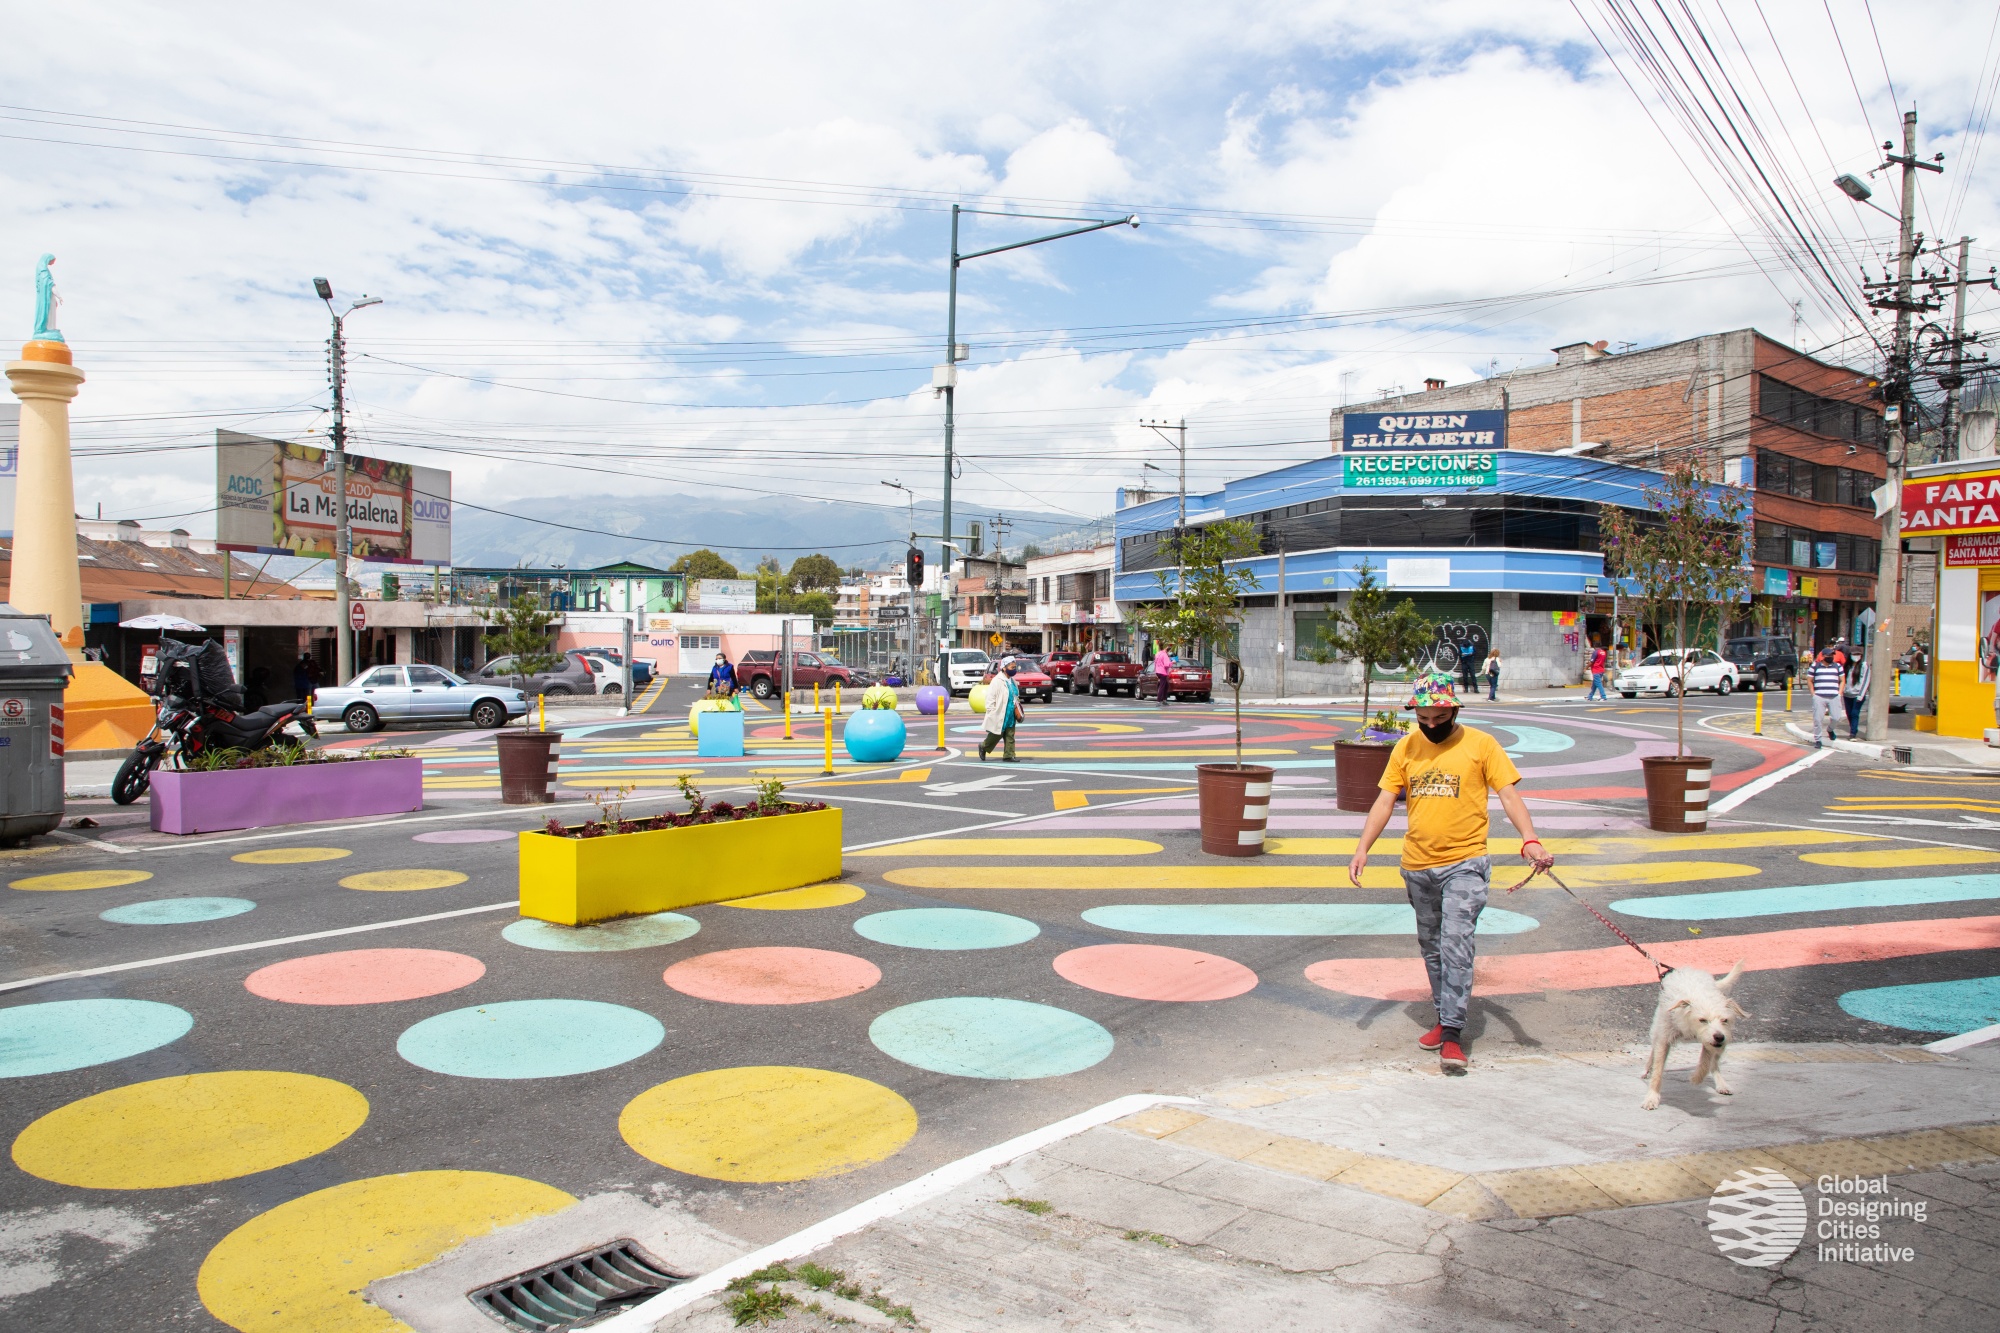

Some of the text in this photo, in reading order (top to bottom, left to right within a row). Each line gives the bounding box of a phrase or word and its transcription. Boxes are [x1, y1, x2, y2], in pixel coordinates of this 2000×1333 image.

[1378, 415, 1468, 432] QUEEN
[1350, 454, 1492, 472] RECEPCIONES
[228, 475, 262, 496] ACDC
[322, 478, 372, 497] MECADO
[291, 491, 310, 514] La
[1899, 504, 2000, 529] SANTA
[1957, 535, 2000, 547] FARMACIA
[1948, 547, 1977, 559] SANTA
